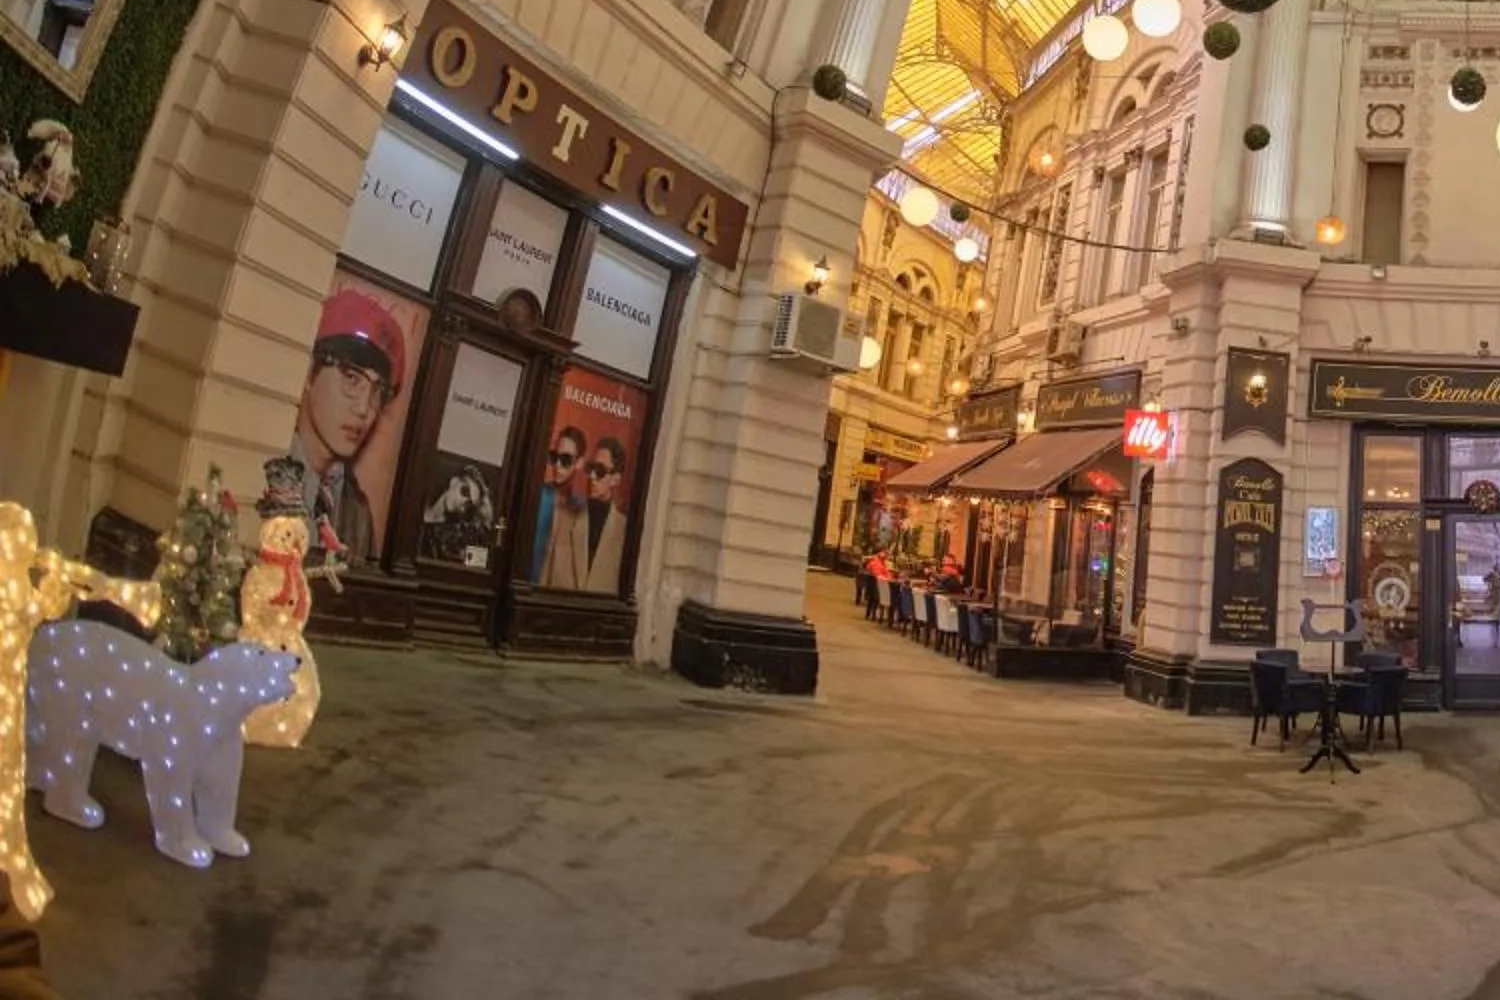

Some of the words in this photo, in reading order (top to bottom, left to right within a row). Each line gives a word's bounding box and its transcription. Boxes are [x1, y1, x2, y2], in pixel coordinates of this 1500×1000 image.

[432, 27, 718, 246] OPTICA
[585, 287, 651, 326] BALENCIAGA
[564, 385, 632, 420] BALENCIAGA
[1127, 416, 1167, 454] illy
